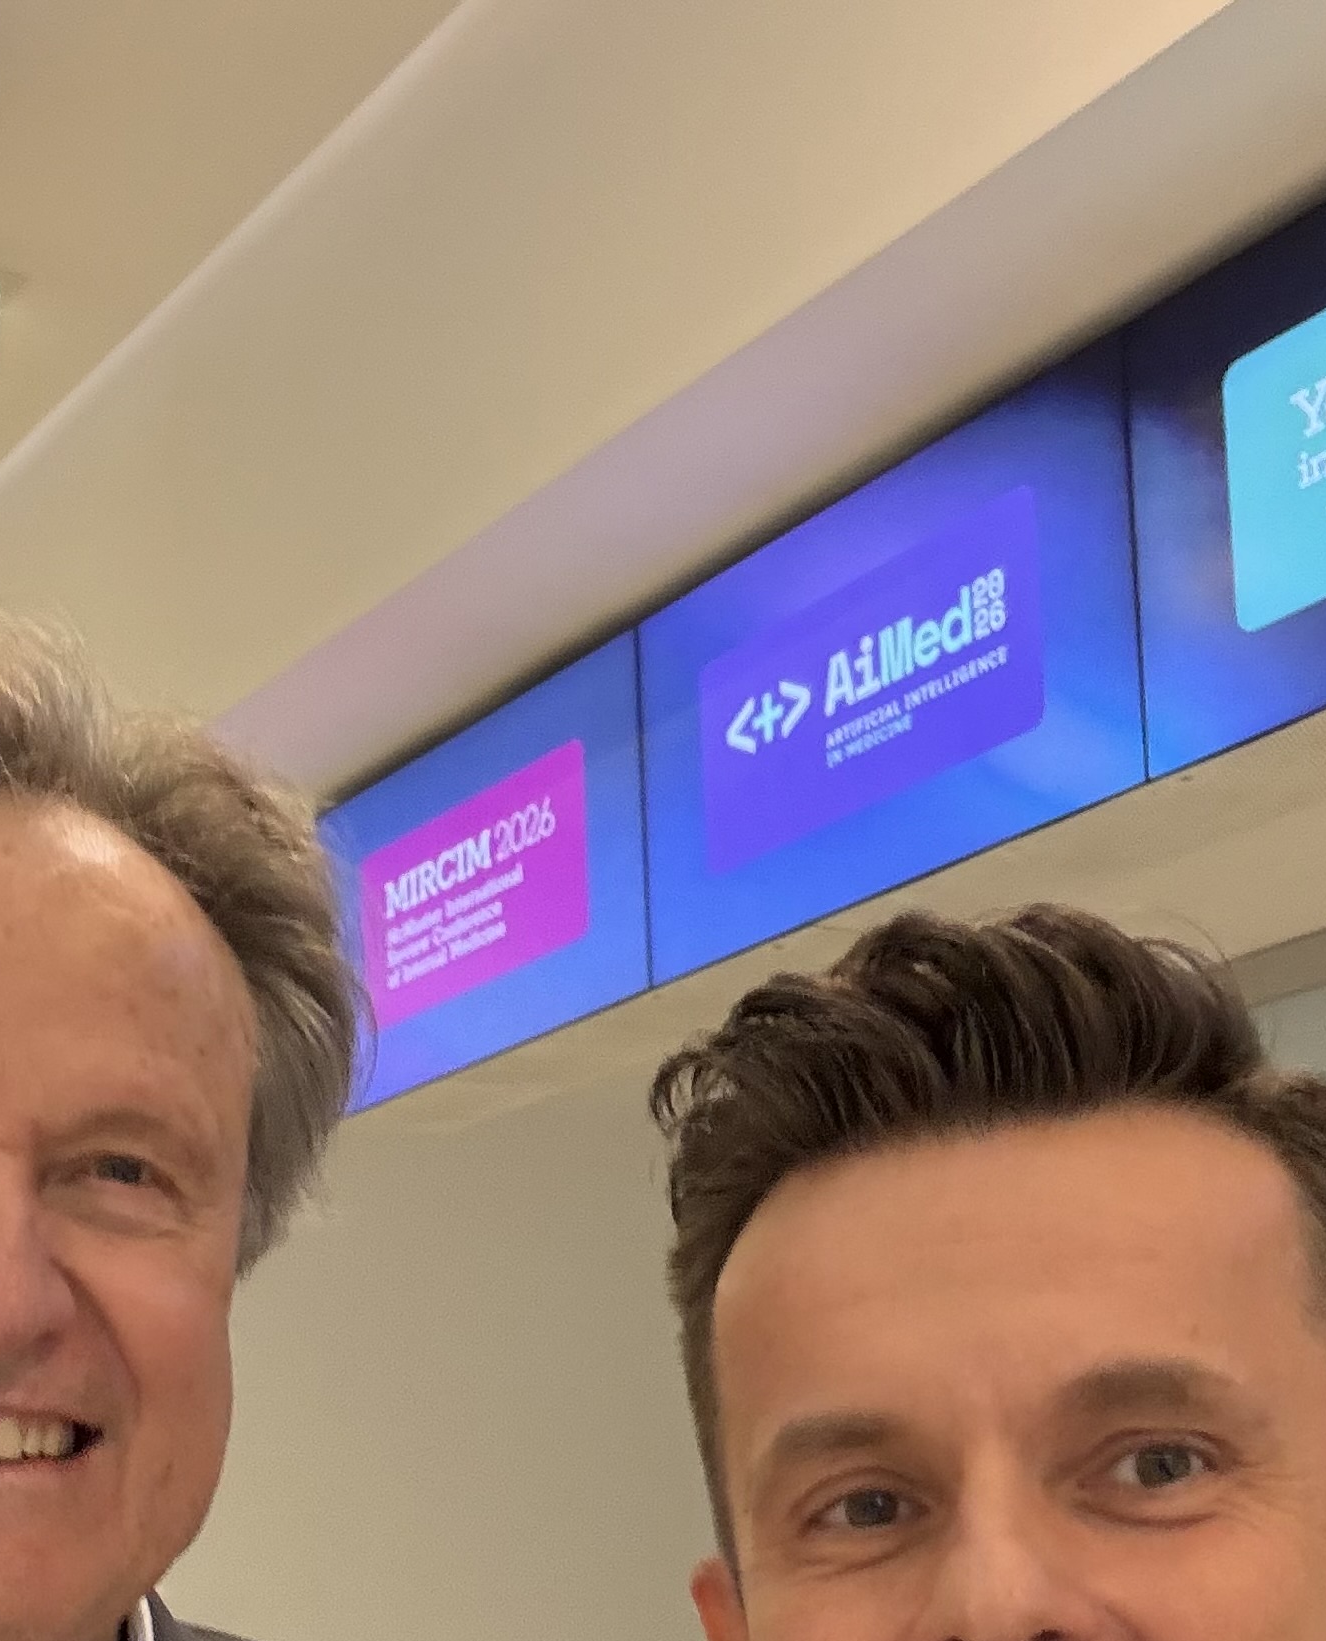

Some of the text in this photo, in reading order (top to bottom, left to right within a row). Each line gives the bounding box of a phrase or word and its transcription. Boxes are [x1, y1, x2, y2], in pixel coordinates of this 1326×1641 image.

[824, 584, 973, 717] AiMed
[384, 796, 557, 919] MIRCIM 2026
